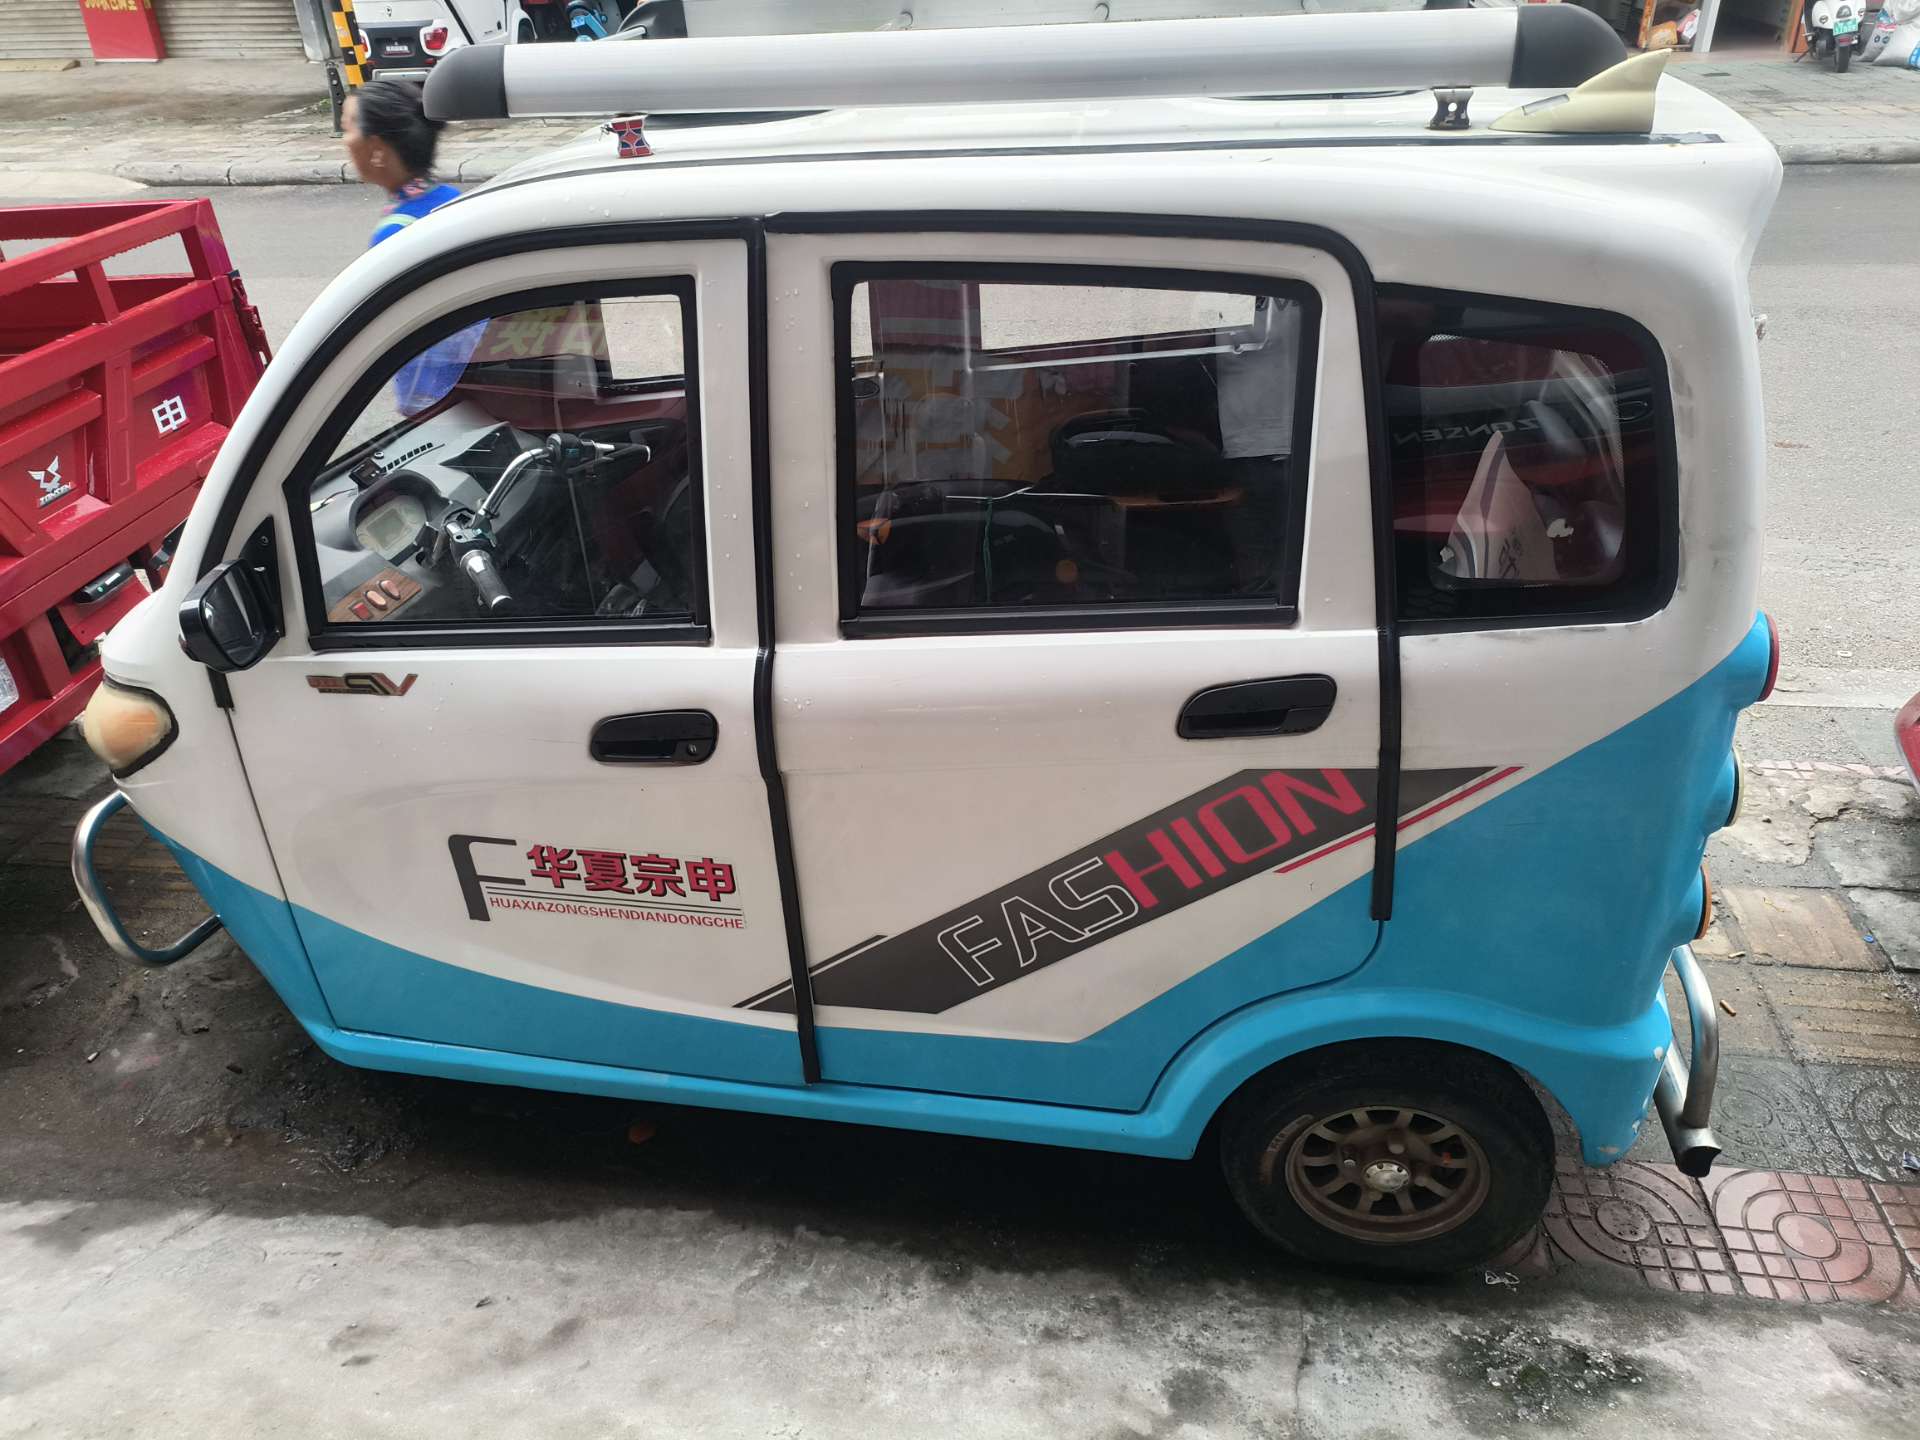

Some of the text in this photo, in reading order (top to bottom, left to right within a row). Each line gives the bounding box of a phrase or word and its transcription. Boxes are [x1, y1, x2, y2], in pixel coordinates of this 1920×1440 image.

[152, 395, 188, 434] 申
[526, 844, 737, 903] 华夏宗申
[937, 767, 1367, 986] FASHION
[489, 896, 745, 930] HUAXIAZONGSHENDIANDONGCHE
